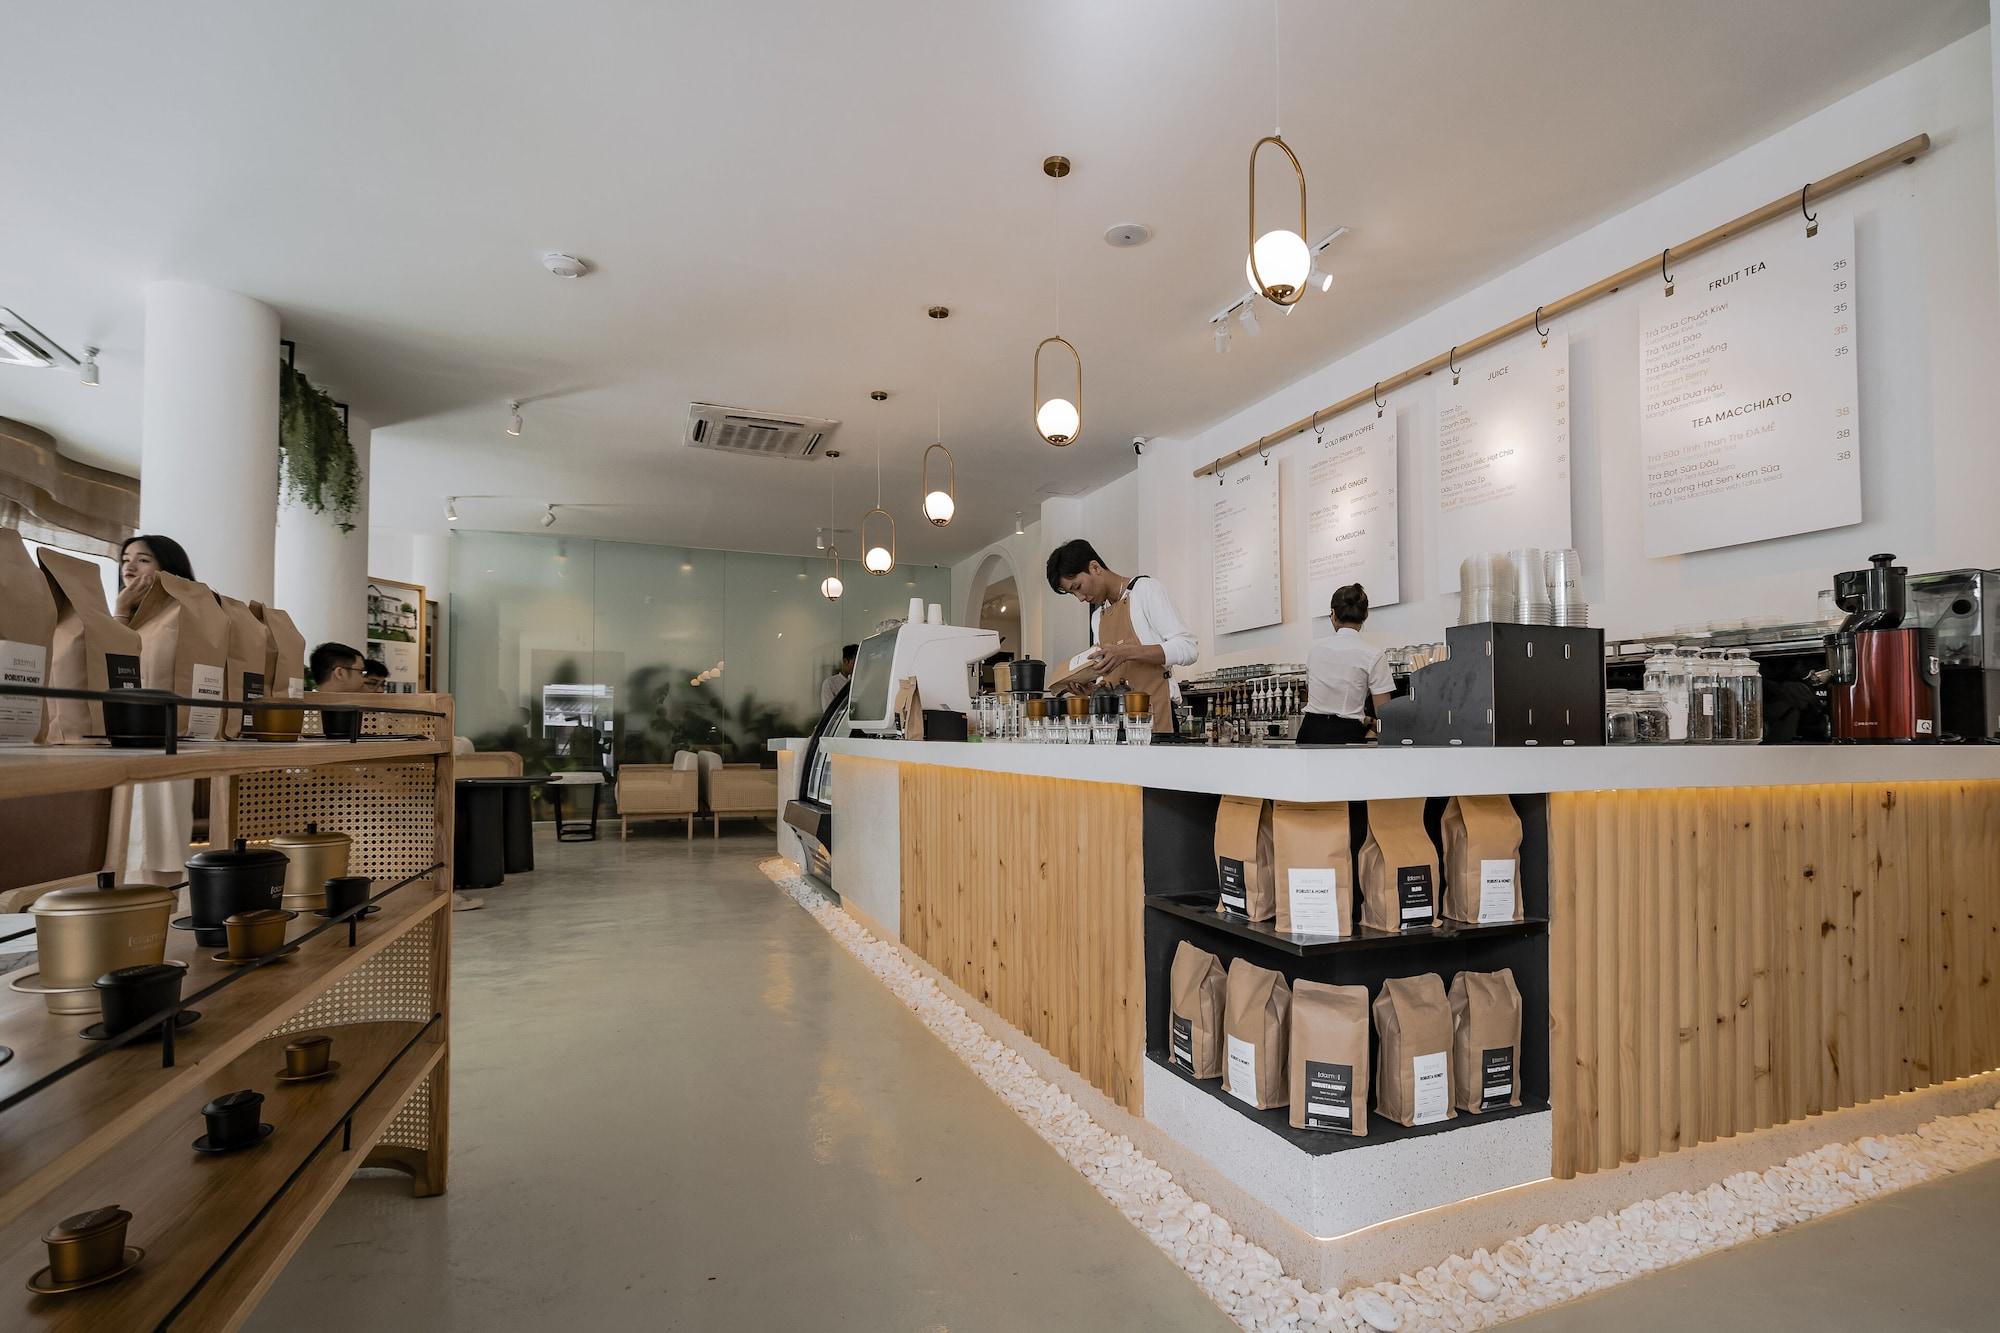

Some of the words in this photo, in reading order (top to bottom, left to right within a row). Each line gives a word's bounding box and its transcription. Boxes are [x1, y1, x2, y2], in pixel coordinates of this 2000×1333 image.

[1832, 259, 1847, 271] 35
[1709, 271, 1740, 291] FRUIT
[1744, 261, 1766, 278] TEA
[1832, 281, 1848, 293] 35
[1710, 303, 1728, 314] Kiwi
[1833, 302, 1848, 314] 35
[1834, 324, 1848, 336] 35
[1835, 346, 1849, 358] 35
[1488, 366, 1510, 380] JUICE
[1692, 416, 1712, 428] TEA
[1716, 392, 1792, 422] MACCHIATO
[1835, 406, 1850, 418] 38
[1324, 439, 1338, 449] COLD
[1339, 432, 1354, 443] BREW
[1355, 423, 1374, 437] COFFEE
[1836, 428, 1850, 440] 38
[1837, 450, 1851, 462] 38
[1348, 477, 1368, 489] GINGER
[1674, 484, 1695, 498] Long
[1716, 475, 1733, 485] Sen
[1735, 470, 1758, 480] Kem
[1335, 529, 1366, 542] KOMBUCHA
[4, 673, 26, 682] ROBUSTA
